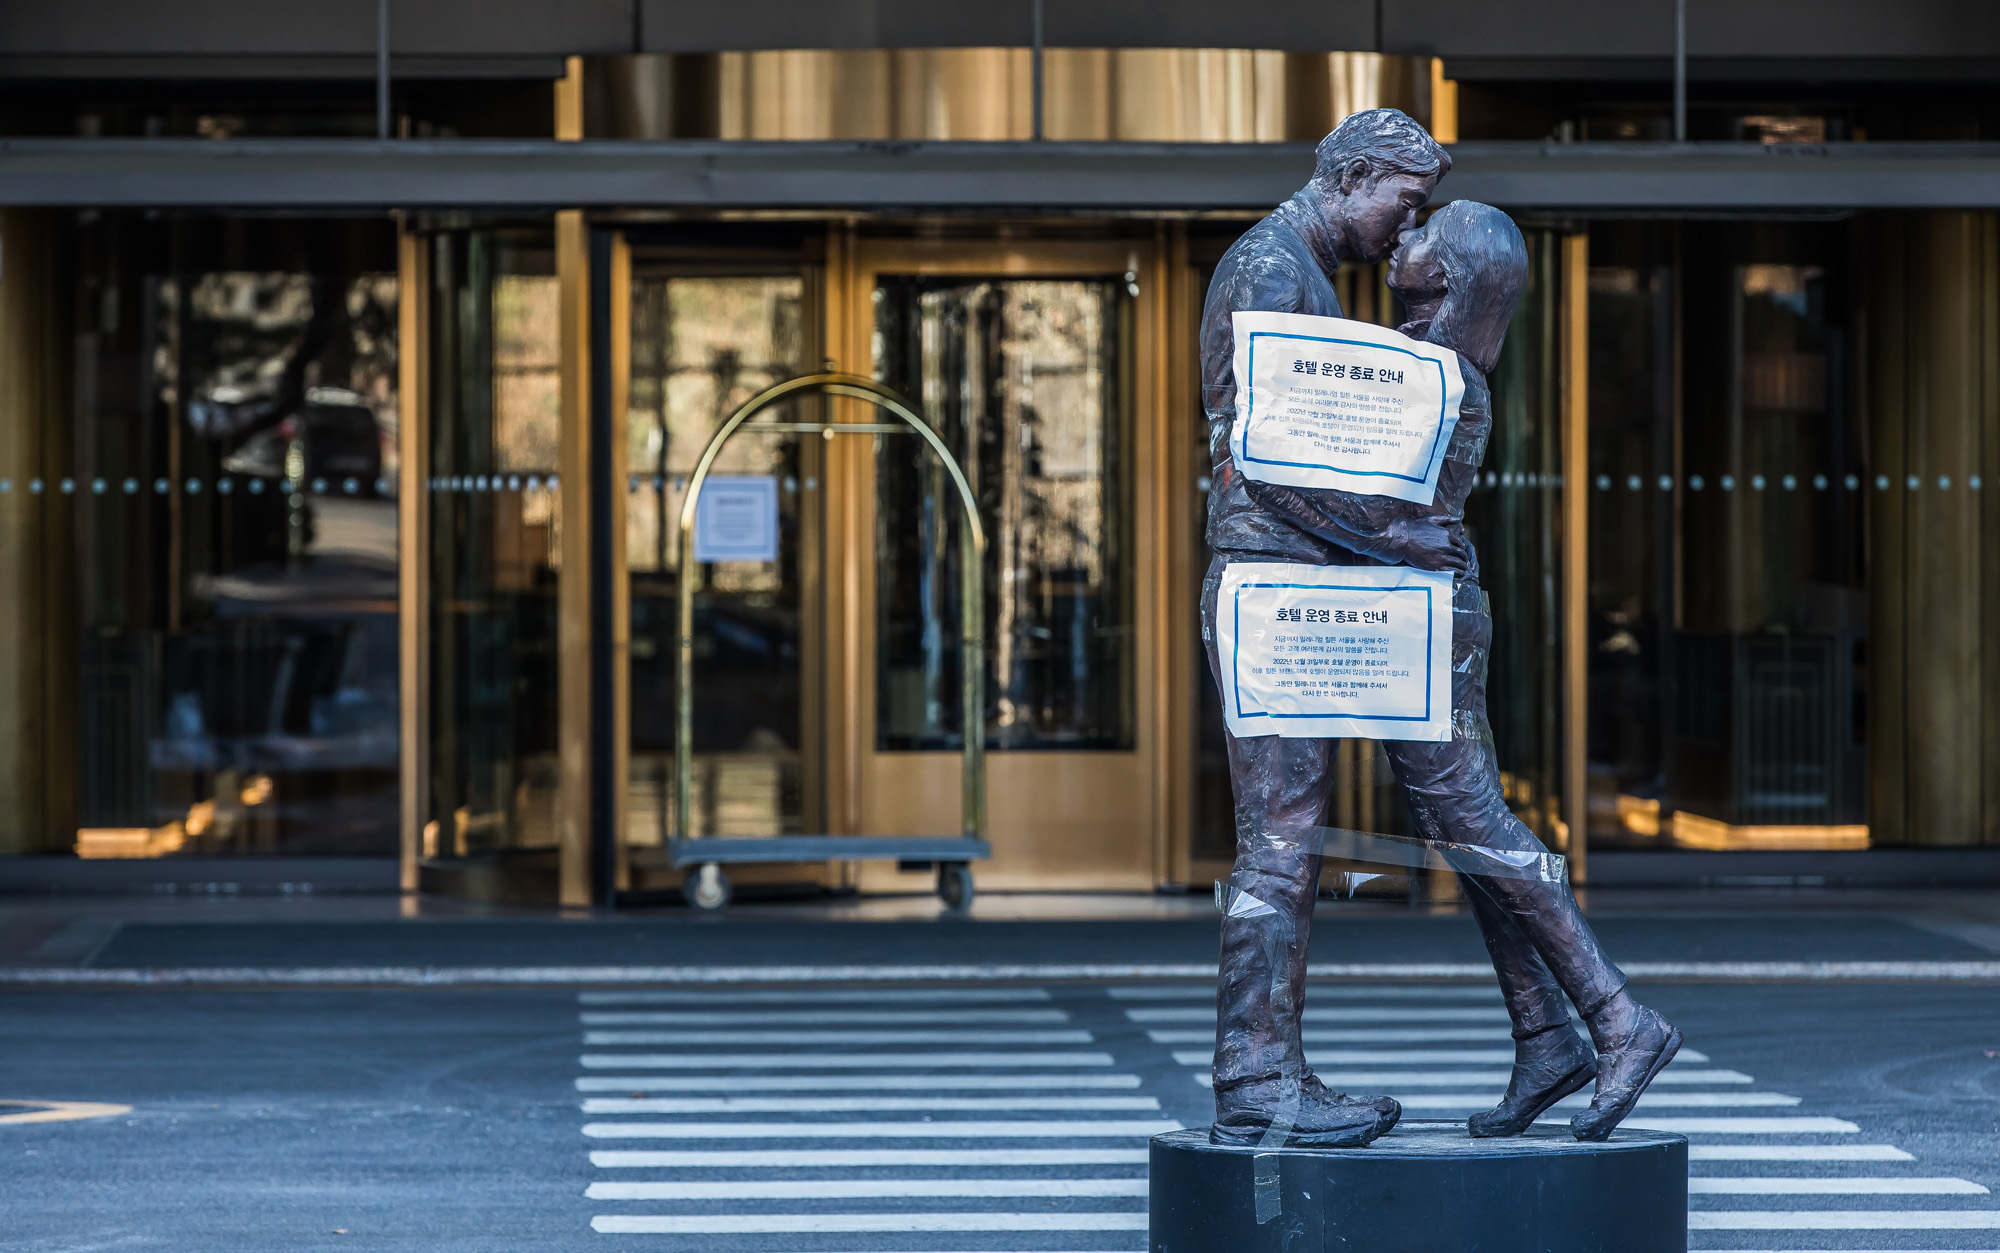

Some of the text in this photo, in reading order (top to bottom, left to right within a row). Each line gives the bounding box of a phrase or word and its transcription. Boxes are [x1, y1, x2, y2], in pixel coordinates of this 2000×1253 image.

[1292, 360, 1403, 384] 호텔 운영 종료 안내
[1276, 608, 1387, 624] 호텔 운영 종료 안내
